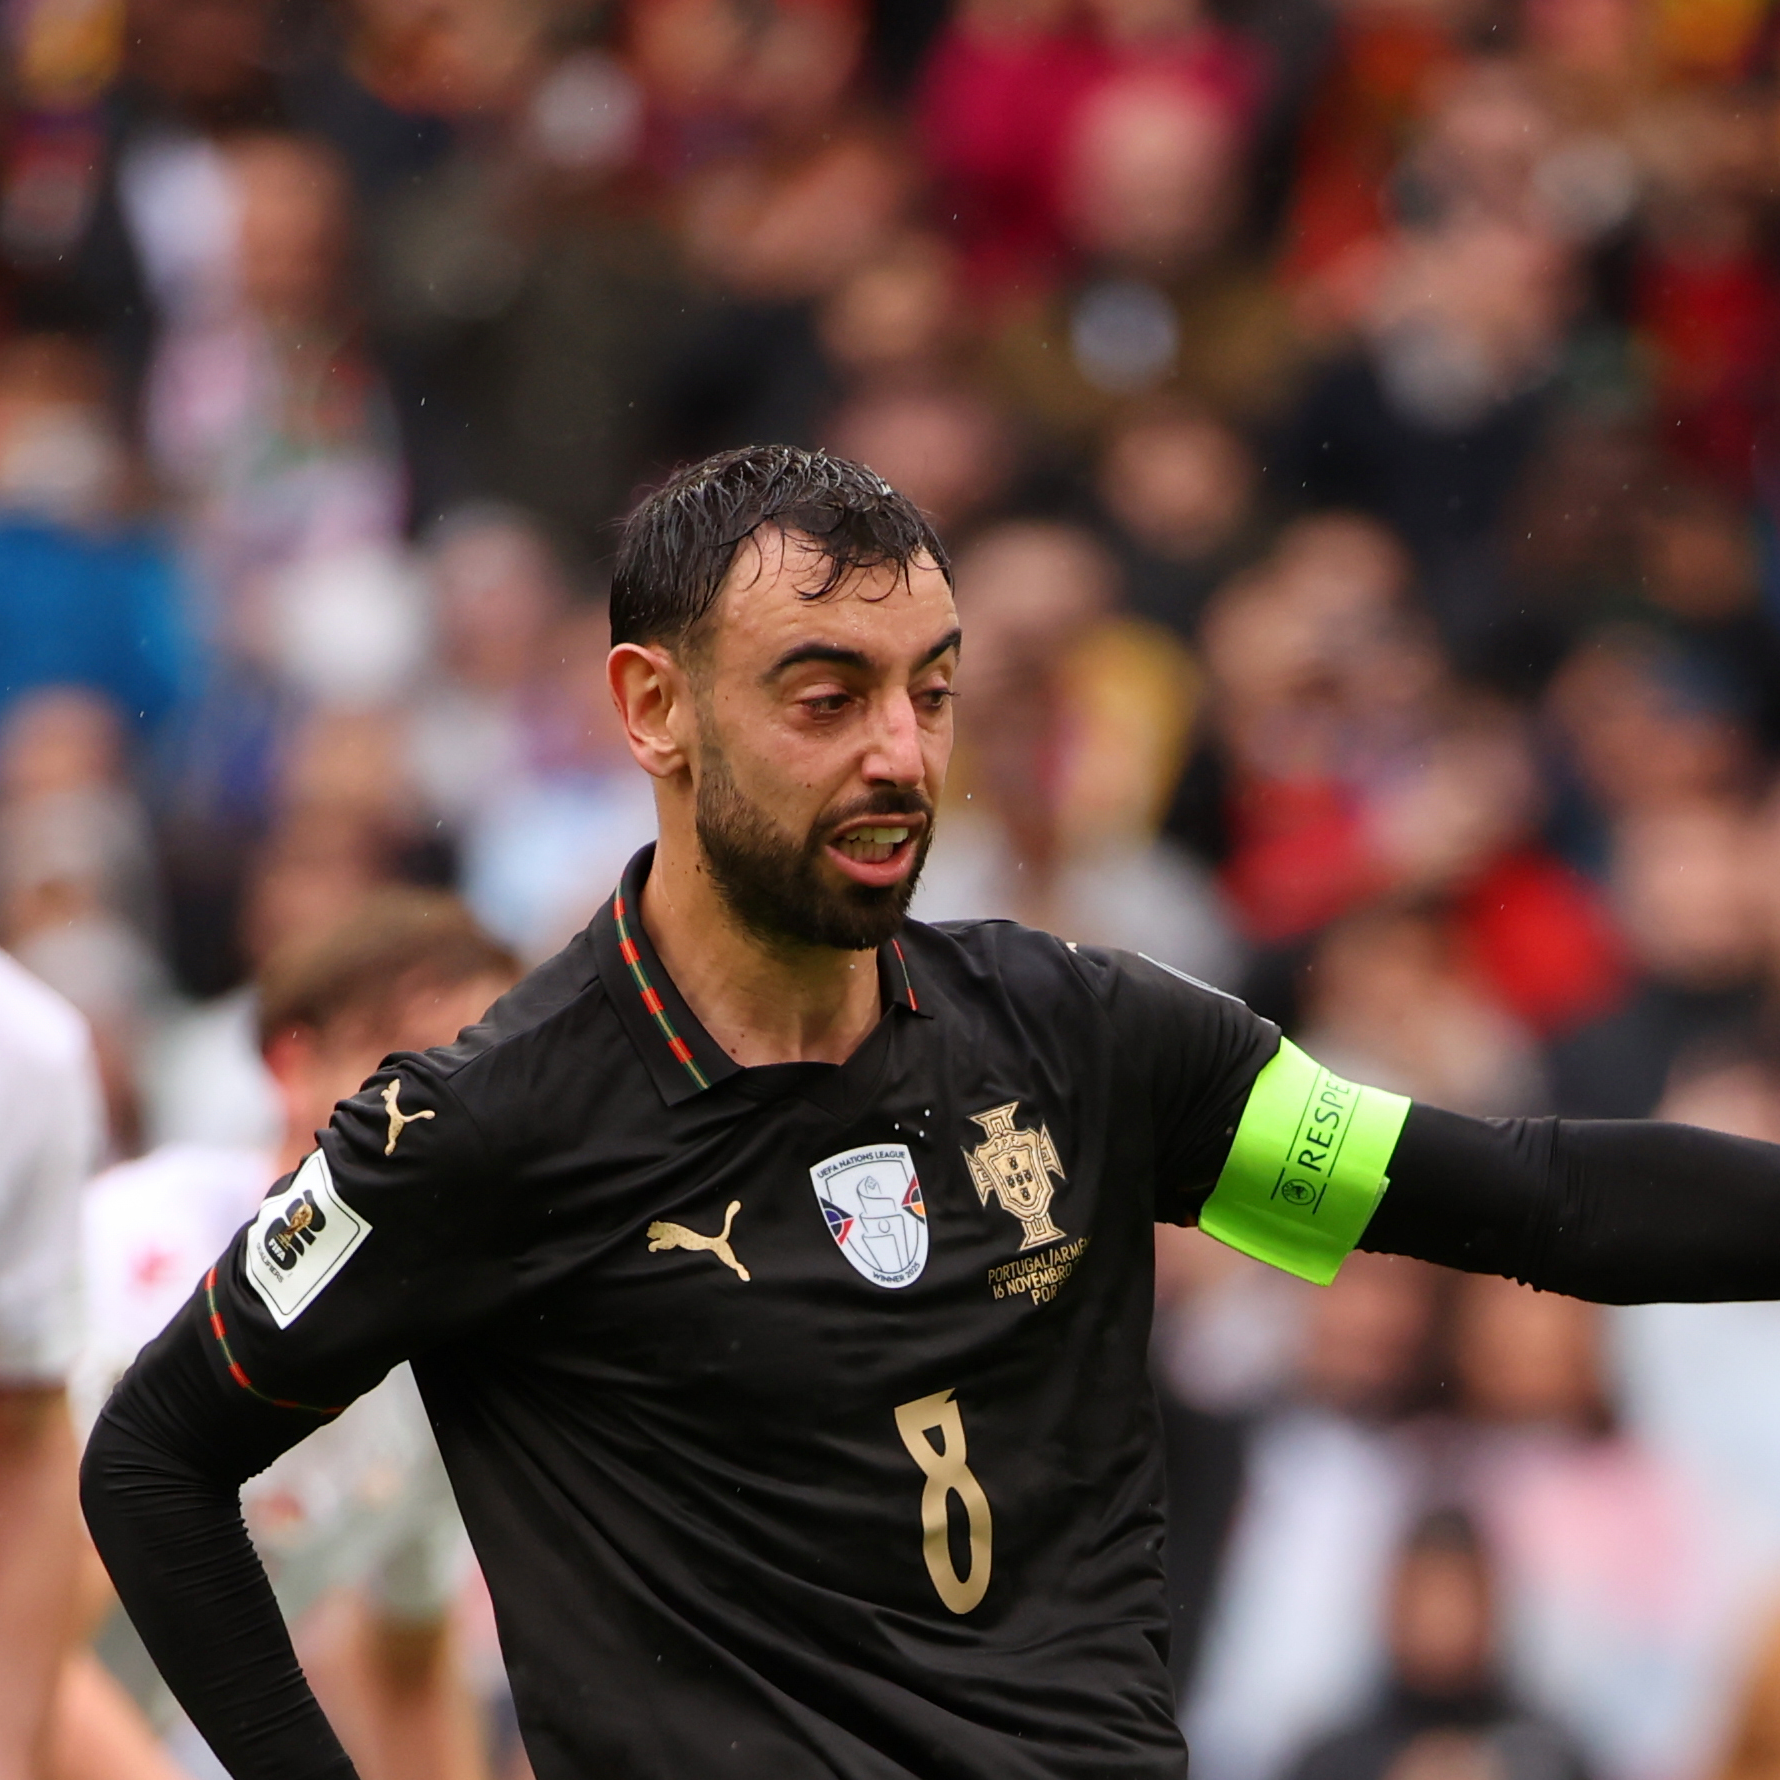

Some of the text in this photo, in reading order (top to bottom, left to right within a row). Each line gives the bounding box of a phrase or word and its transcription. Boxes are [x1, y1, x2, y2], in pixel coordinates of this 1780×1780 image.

[817, 1151, 906, 1178] UEFA NATIONS LEAGUE
[268, 1238, 286, 1261] FIFA
[873, 1261, 920, 1283] WINNER 2025
[993, 1263, 1072, 1300] 16 NOVEMBRO
[893, 1388, 993, 1615] 8
